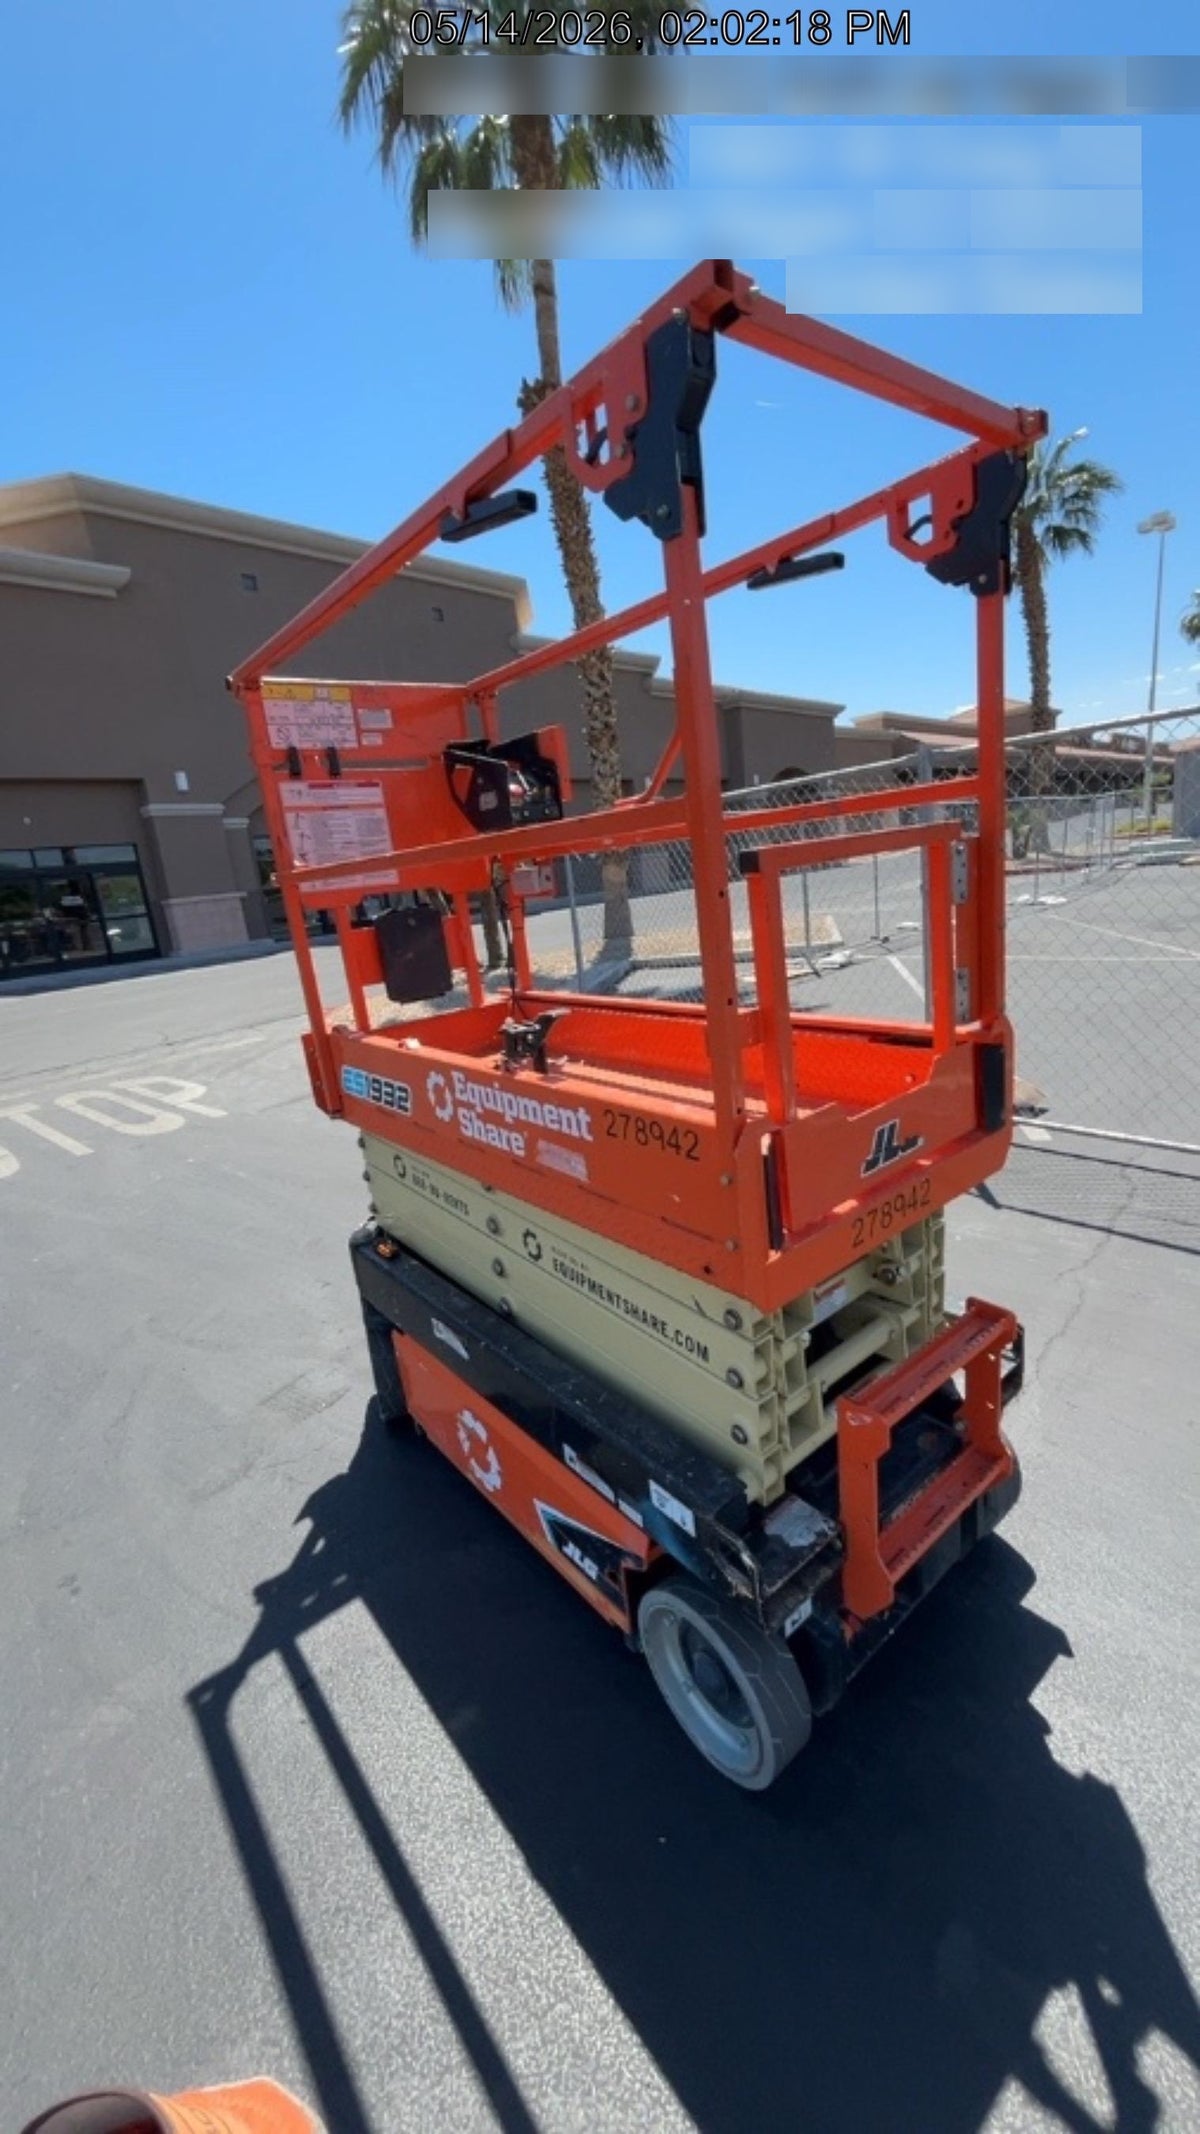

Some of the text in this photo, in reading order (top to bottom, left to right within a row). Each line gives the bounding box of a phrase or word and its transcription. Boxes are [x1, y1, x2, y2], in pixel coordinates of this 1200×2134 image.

[343, 1067, 410, 1113] ES1932
[452, 1071, 593, 1142] Equipment
[0, 1076, 229, 1180] TOP
[457, 1106, 525, 1158] Share
[603, 1108, 701, 1161] 278942
[852, 1177, 932, 1248] 278942
[552, 1256, 711, 1363] EQUIPMENTSHARE.COM
